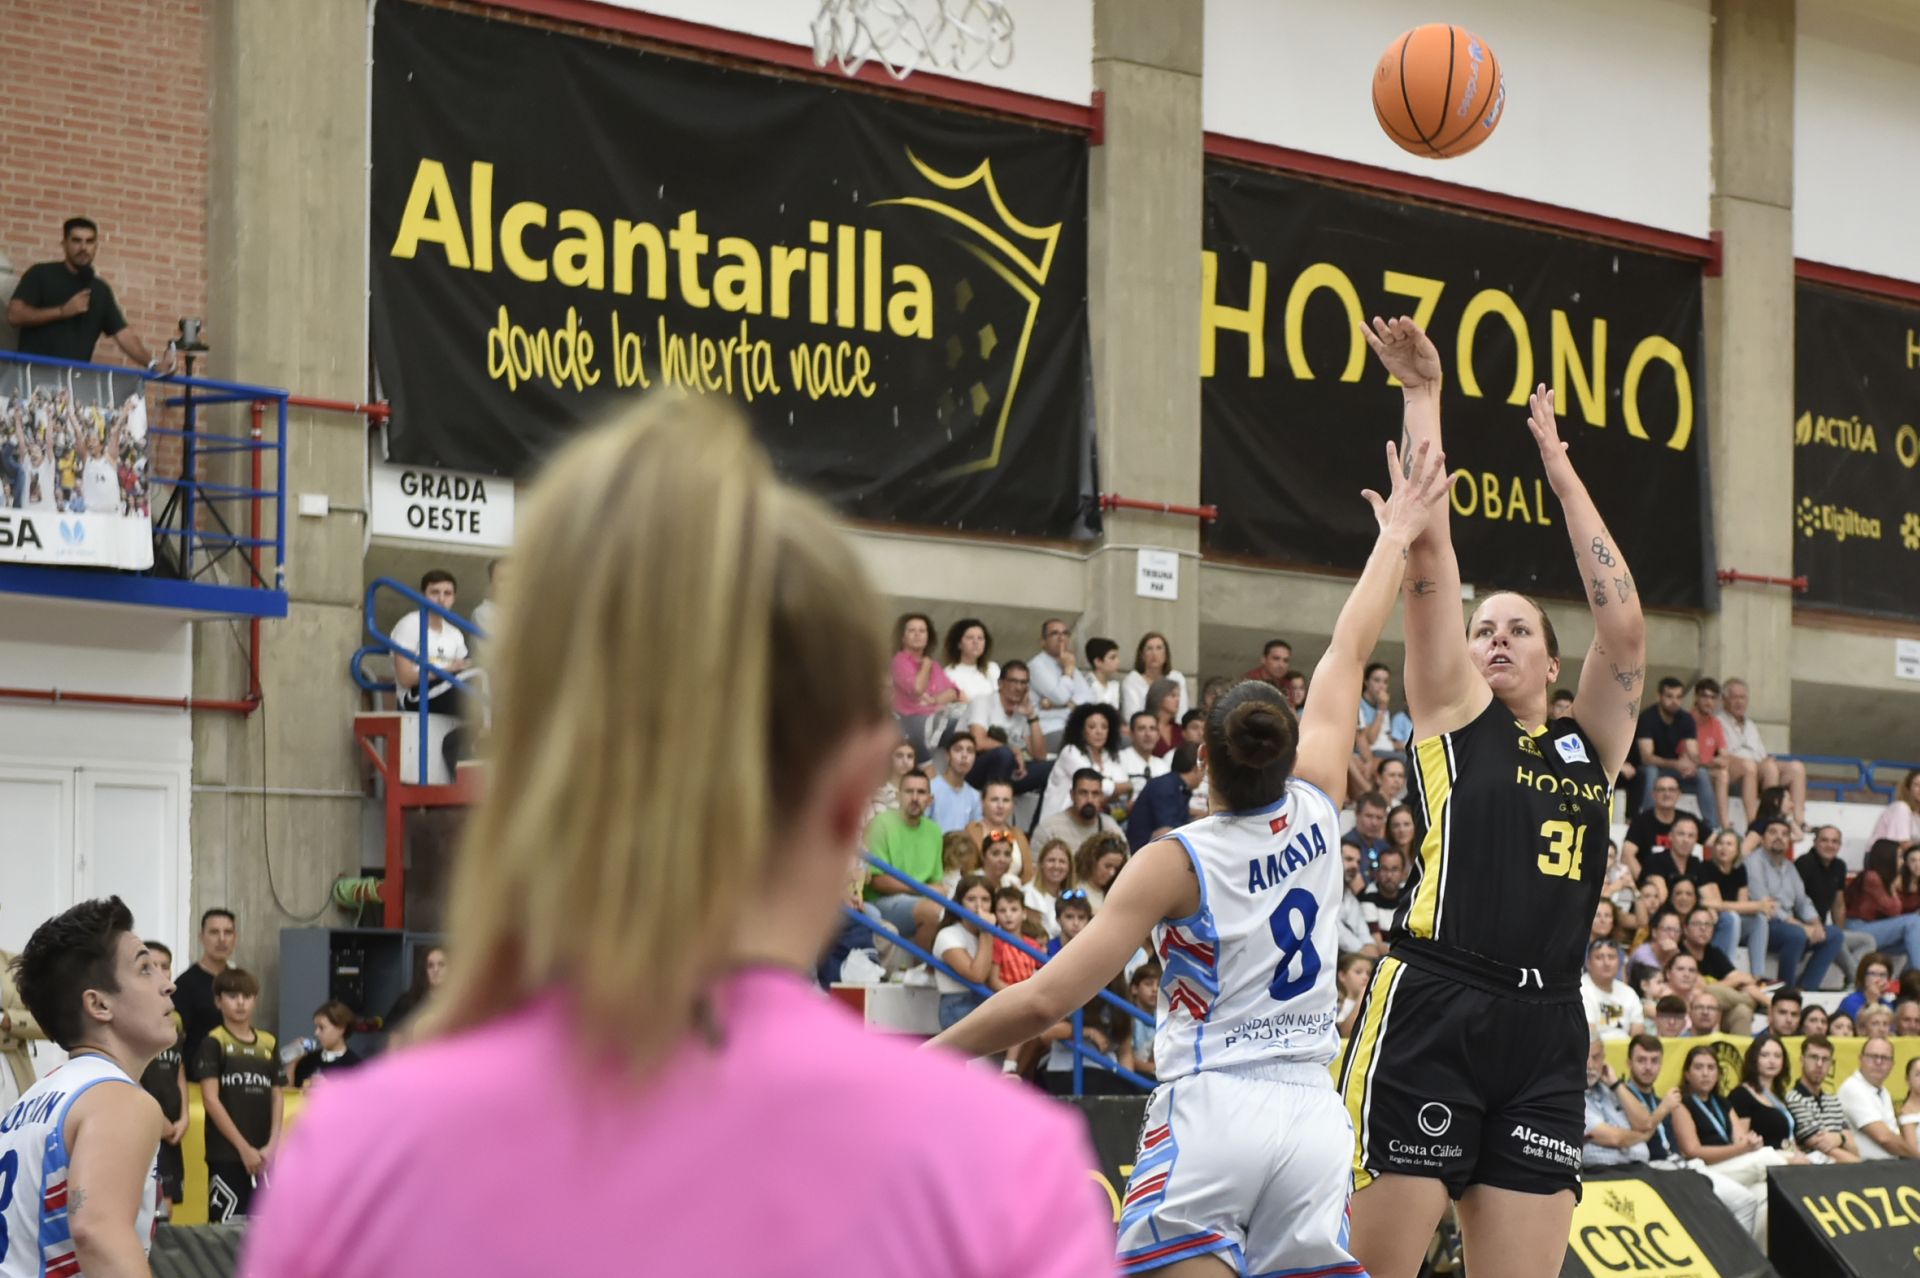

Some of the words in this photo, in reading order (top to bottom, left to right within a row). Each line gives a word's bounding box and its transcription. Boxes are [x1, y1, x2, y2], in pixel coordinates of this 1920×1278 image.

[390, 158, 933, 339] Alcantarilla
[487, 304, 600, 391] donde
[611, 309, 650, 389] la
[658, 315, 780, 402] huerta
[790, 340, 876, 400] nace
[1814, 414, 1878, 454] ACTÚA
[401, 470, 487, 504] GRADA
[1451, 468, 1552, 525] OBAL
[407, 504, 481, 534] OESTE
[1269, 888, 1321, 1001] 8
[1389, 1140, 1427, 1155] Costa
[1430, 1144, 1463, 1157] Cálida
[1579, 1222, 1693, 1271] CRC
